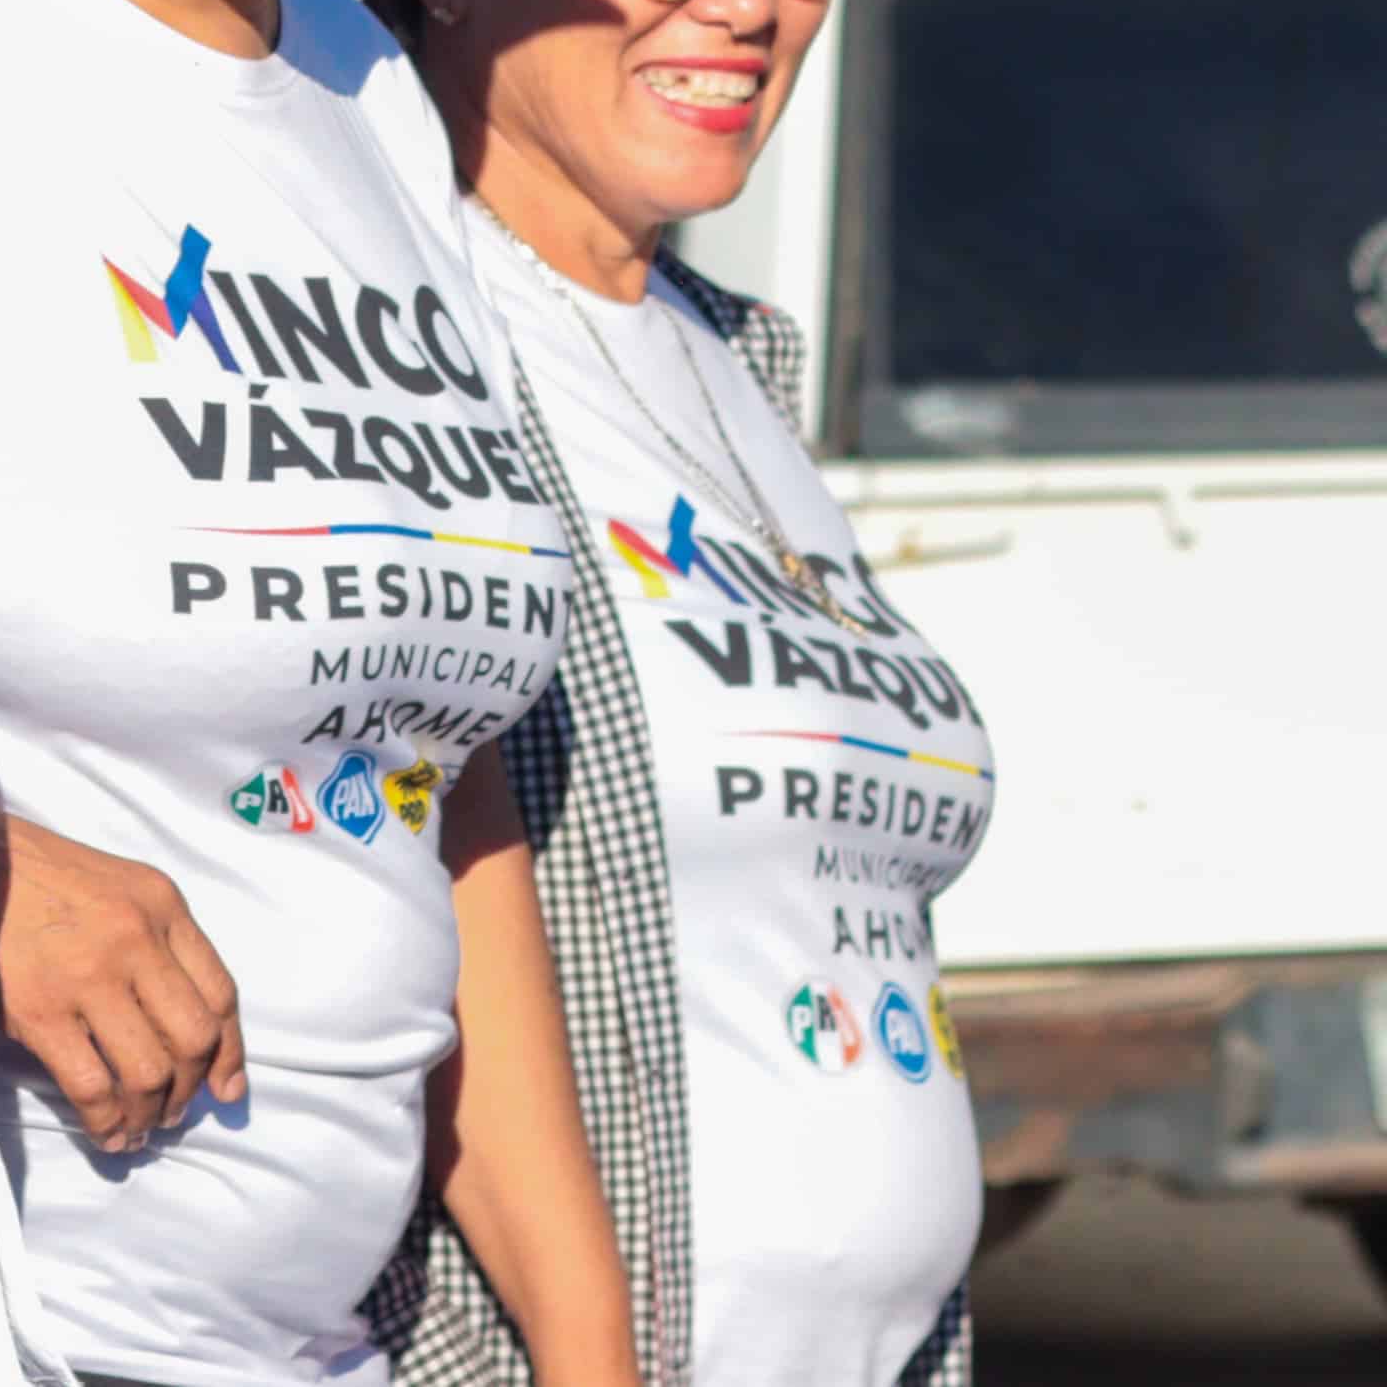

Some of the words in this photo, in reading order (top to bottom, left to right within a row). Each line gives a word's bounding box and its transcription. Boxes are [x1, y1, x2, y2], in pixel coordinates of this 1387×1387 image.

[100, 223, 489, 402] MINGO
[310, 643, 541, 697] MUNICIPAL
[301, 699, 503, 746] AHOME
[332, 771, 375, 822] PAN
